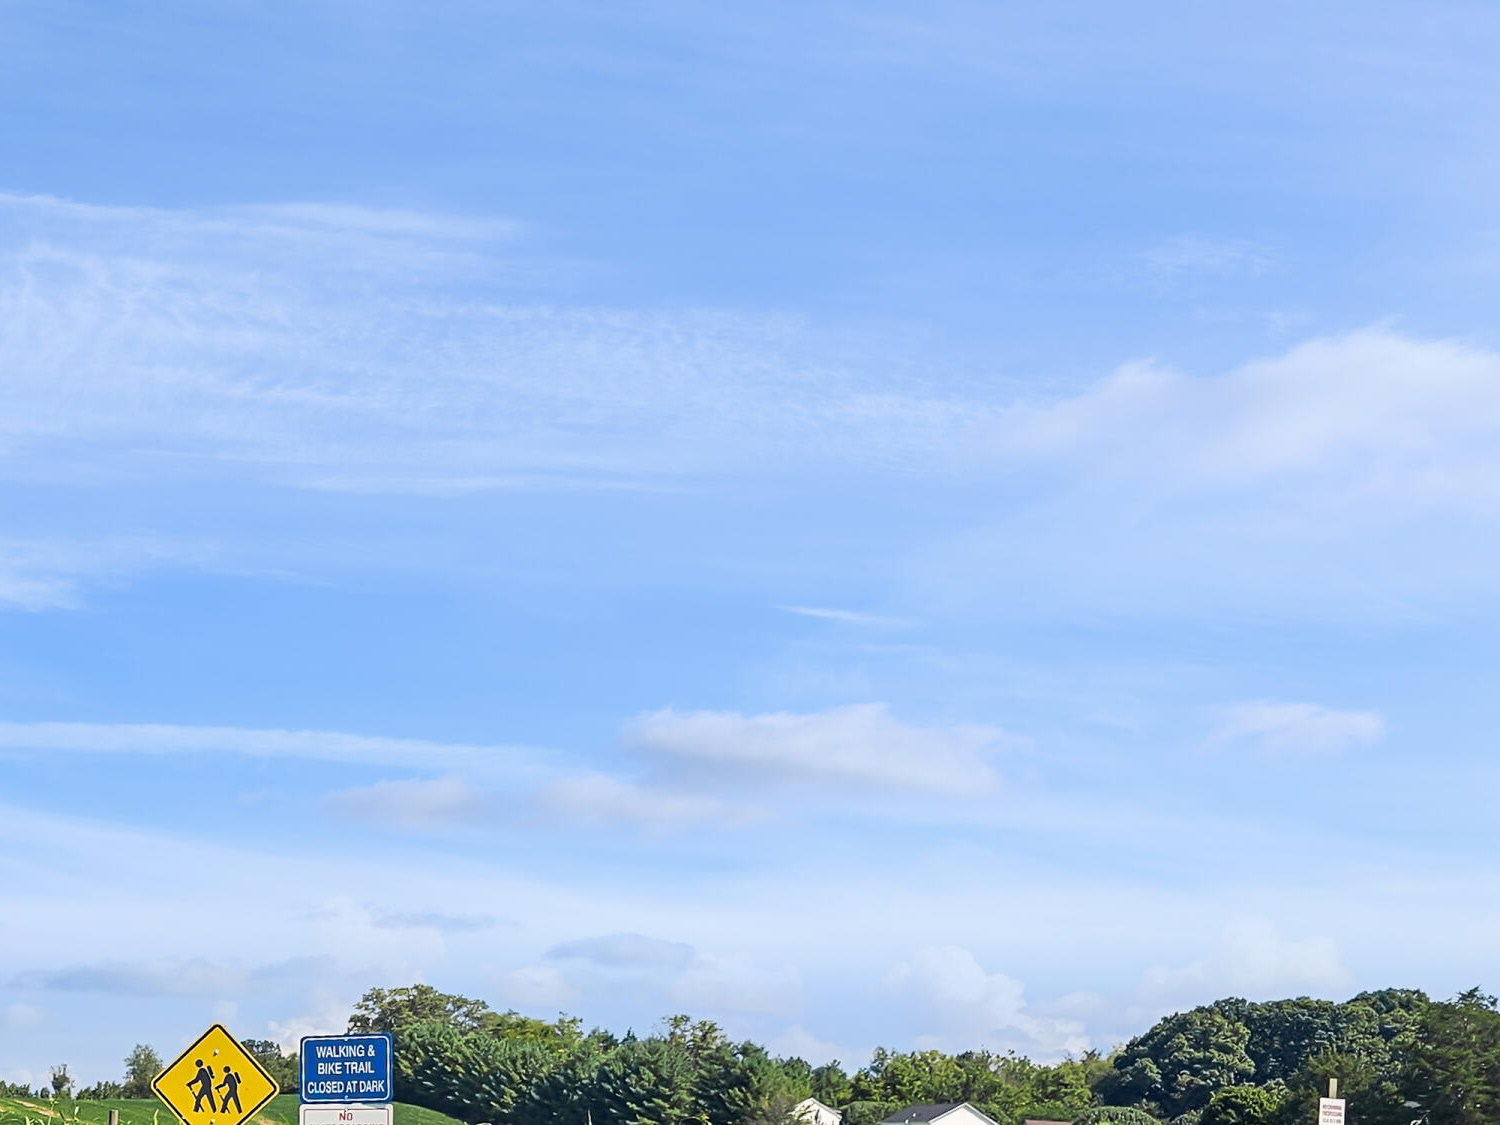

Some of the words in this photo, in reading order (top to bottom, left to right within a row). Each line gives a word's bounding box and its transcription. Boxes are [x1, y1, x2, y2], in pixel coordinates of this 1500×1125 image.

[316, 1045, 365, 1058] WALKING
[367, 1044, 375, 1057] &
[317, 1062, 342, 1075] BIKE
[344, 1061, 375, 1074] TRAIL
[307, 1081, 344, 1094] CLOSED
[346, 1080, 357, 1093] AT
[359, 1080, 385, 1093] DARK
[339, 1112, 353, 1121] NO
